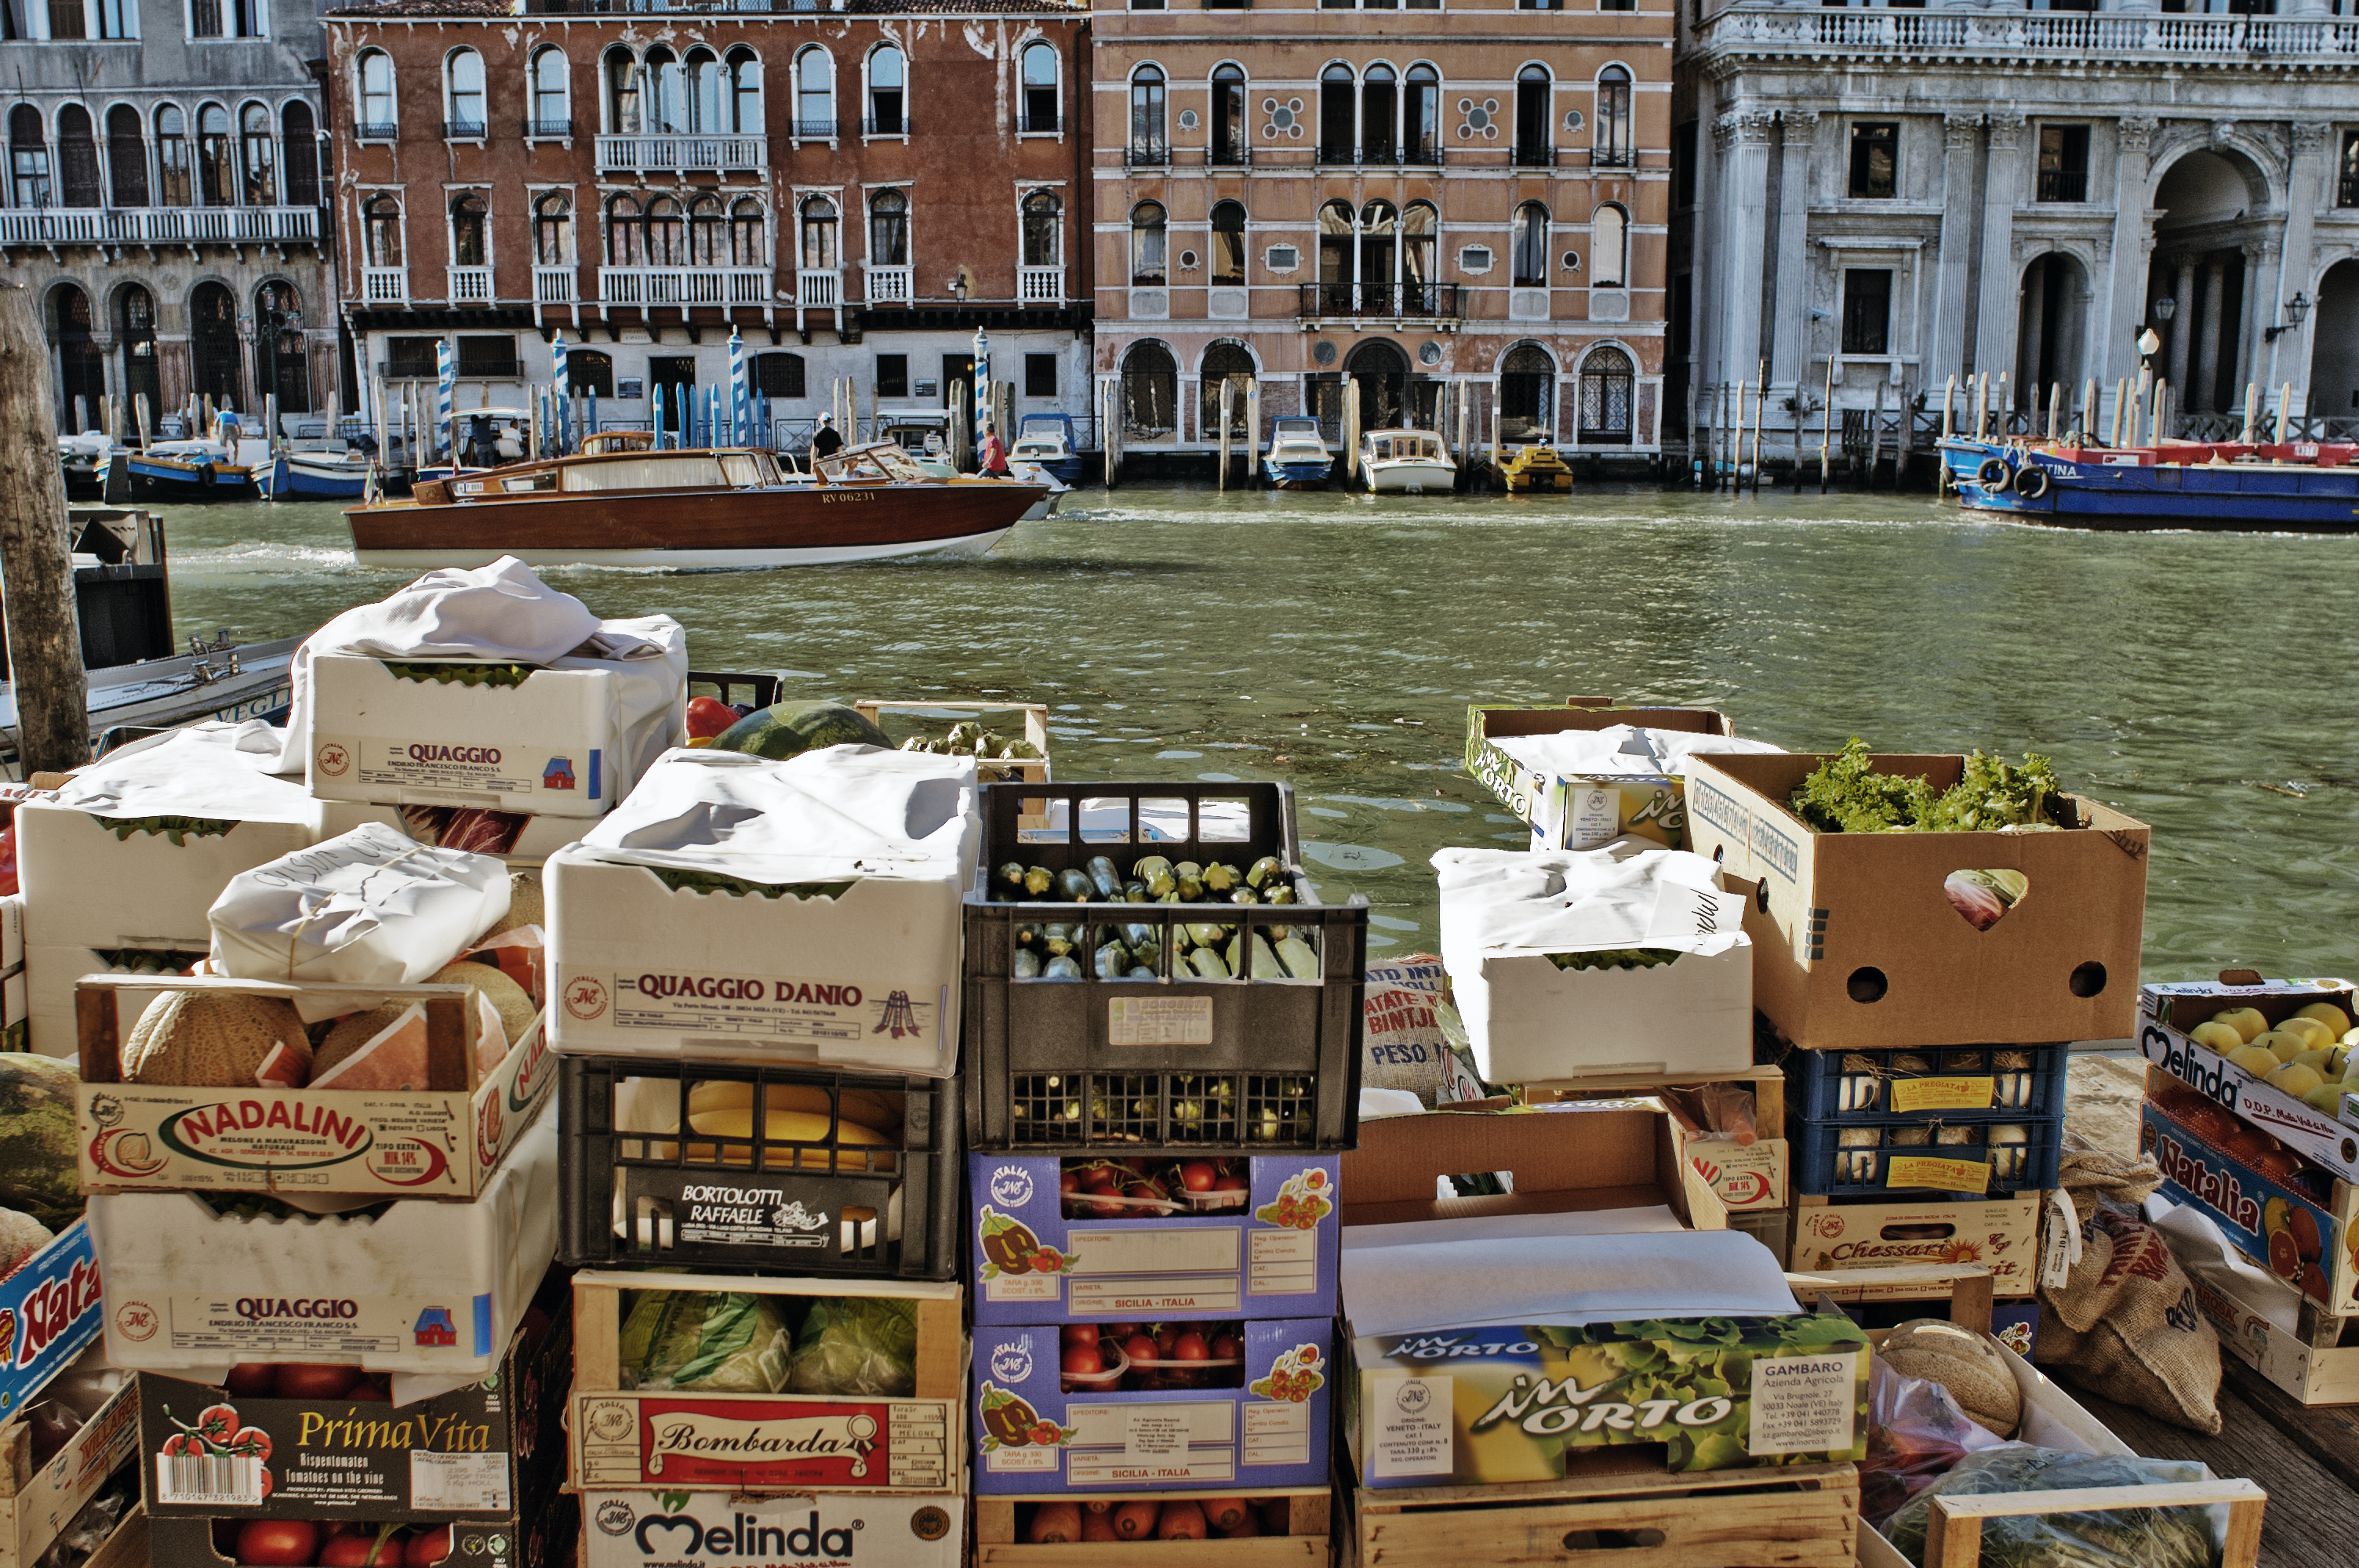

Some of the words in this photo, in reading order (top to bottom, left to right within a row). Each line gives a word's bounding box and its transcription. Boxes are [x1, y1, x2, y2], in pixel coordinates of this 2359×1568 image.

[2039, 463, 2077, 476] TINA
[822, 493, 837, 503] RV
[839, 492, 874, 502] 06231
[409, 743, 502, 764] QUAGGIO
[416, 761, 460, 770] FRANCESCO
[1482, 768, 1526, 814] ORTO
[572, 976, 599, 985] ITALIA
[638, 974, 765, 1000] QUAGGIO
[774, 981, 862, 1007] DANIO
[2161, 985, 2214, 994] Melinda
[1365, 990, 1419, 1015] ATATE
[1371, 1044, 1427, 1065] PESO
[2142, 1025, 2237, 1112] Melinda
[1919, 1080, 1960, 1091] PREGIATA
[182, 1100, 366, 1150] NADALINI
[402, 1151, 417, 1165] 14%
[993, 1165, 1028, 1179] ITALIA
[1916, 1161, 1957, 1174] PREGIATA
[2158, 1134, 2260, 1236] Natalia
[682, 1185, 783, 1206] BORTOLOTTI
[690, 1205, 765, 1225] RAFFAELE
[1830, 1240, 1951, 1261] Chessari
[236, 1298, 358, 1321] QUAGGIO
[1114, 1299, 1153, 1308] SICILIA
[1161, 1298, 1195, 1308] ITALIA
[994, 1342, 1028, 1356] ITALIA
[1412, 1341, 1540, 1359] ORTO
[1765, 1362, 1843, 1376] GAMBARO
[1763, 1377, 1801, 1387] Azienda
[1805, 1374, 1844, 1387] Agricola
[1811, 1400, 1826, 1409] (VE)
[1828, 1399, 1844, 1408] Italy
[1522, 1396, 1732, 1435] ORTO
[1810, 1417, 1841, 1426] 5893729
[657, 1423, 846, 1454] Bombarda
[1762, 1428, 1841, 1439] az.gambaro@libero.it
[1776, 1438, 1827, 1446] www.inorto.it
[300, 1452, 369, 1468] Rispentomaten
[285, 1468, 329, 1483] Tomatoes
[332, 1472, 343, 1483] on
[346, 1471, 361, 1484] the
[365, 1471, 383, 1485] vine
[1112, 1469, 1148, 1478] SICILIA
[1158, 1468, 1190, 1477] ITALIA
[600, 1499, 630, 1510] ITALIA
[634, 1511, 853, 1557] Melinda
